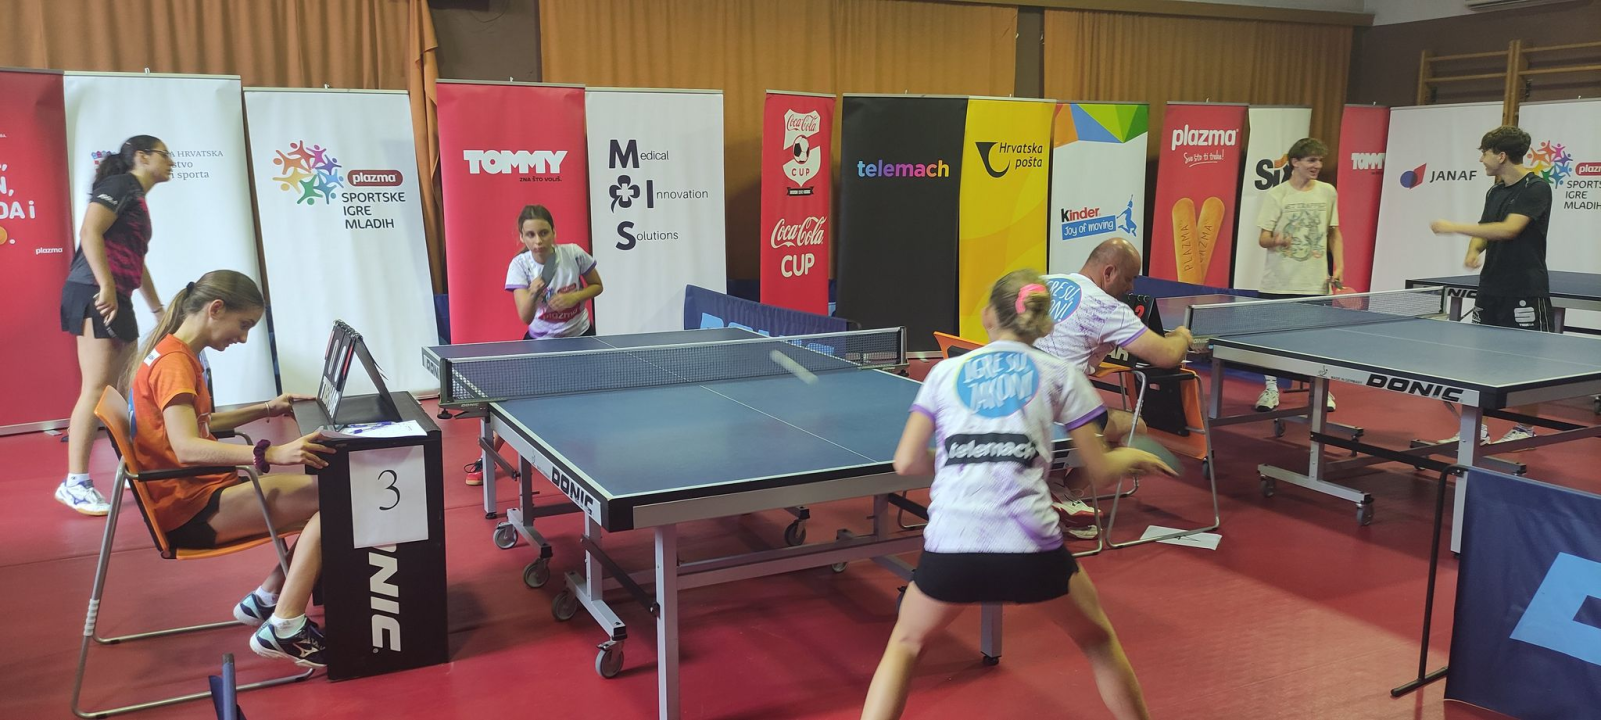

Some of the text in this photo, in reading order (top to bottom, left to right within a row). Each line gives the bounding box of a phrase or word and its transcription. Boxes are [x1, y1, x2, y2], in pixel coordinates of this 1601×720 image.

[1171, 124, 1236, 151] plazma
[177, 150, 224, 158] HRVATSKA
[999, 142, 1043, 154] Hrvatska
[463, 150, 568, 174] TOMMY
[1015, 156, 1043, 170] pošta
[1351, 152, 1386, 170] TOMM
[791, 168, 810, 176] CUP
[857, 159, 950, 178] telemach
[1579, 164, 1601, 175] plaz
[177, 171, 210, 181] sporta
[352, 172, 397, 185] plazma
[1429, 170, 1477, 183] JANAF
[341, 192, 406, 203] SPORTSKE
[1565, 190, 1588, 199] IGRE
[343, 206, 372, 216] IGRE
[345, 219, 395, 229] MLADIH
[1064, 219, 1114, 236] Joy of moving
[770, 216, 827, 249] Coca-Cola
[35, 247, 63, 255] plazma
[1180, 224, 1194, 272] PLAZMA
[781, 253, 815, 278] CUP
[1366, 373, 1464, 403] DONIC
[948, 440, 1037, 460] telemach
[378, 469, 401, 511] 3
[551, 465, 594, 516] DONIC
